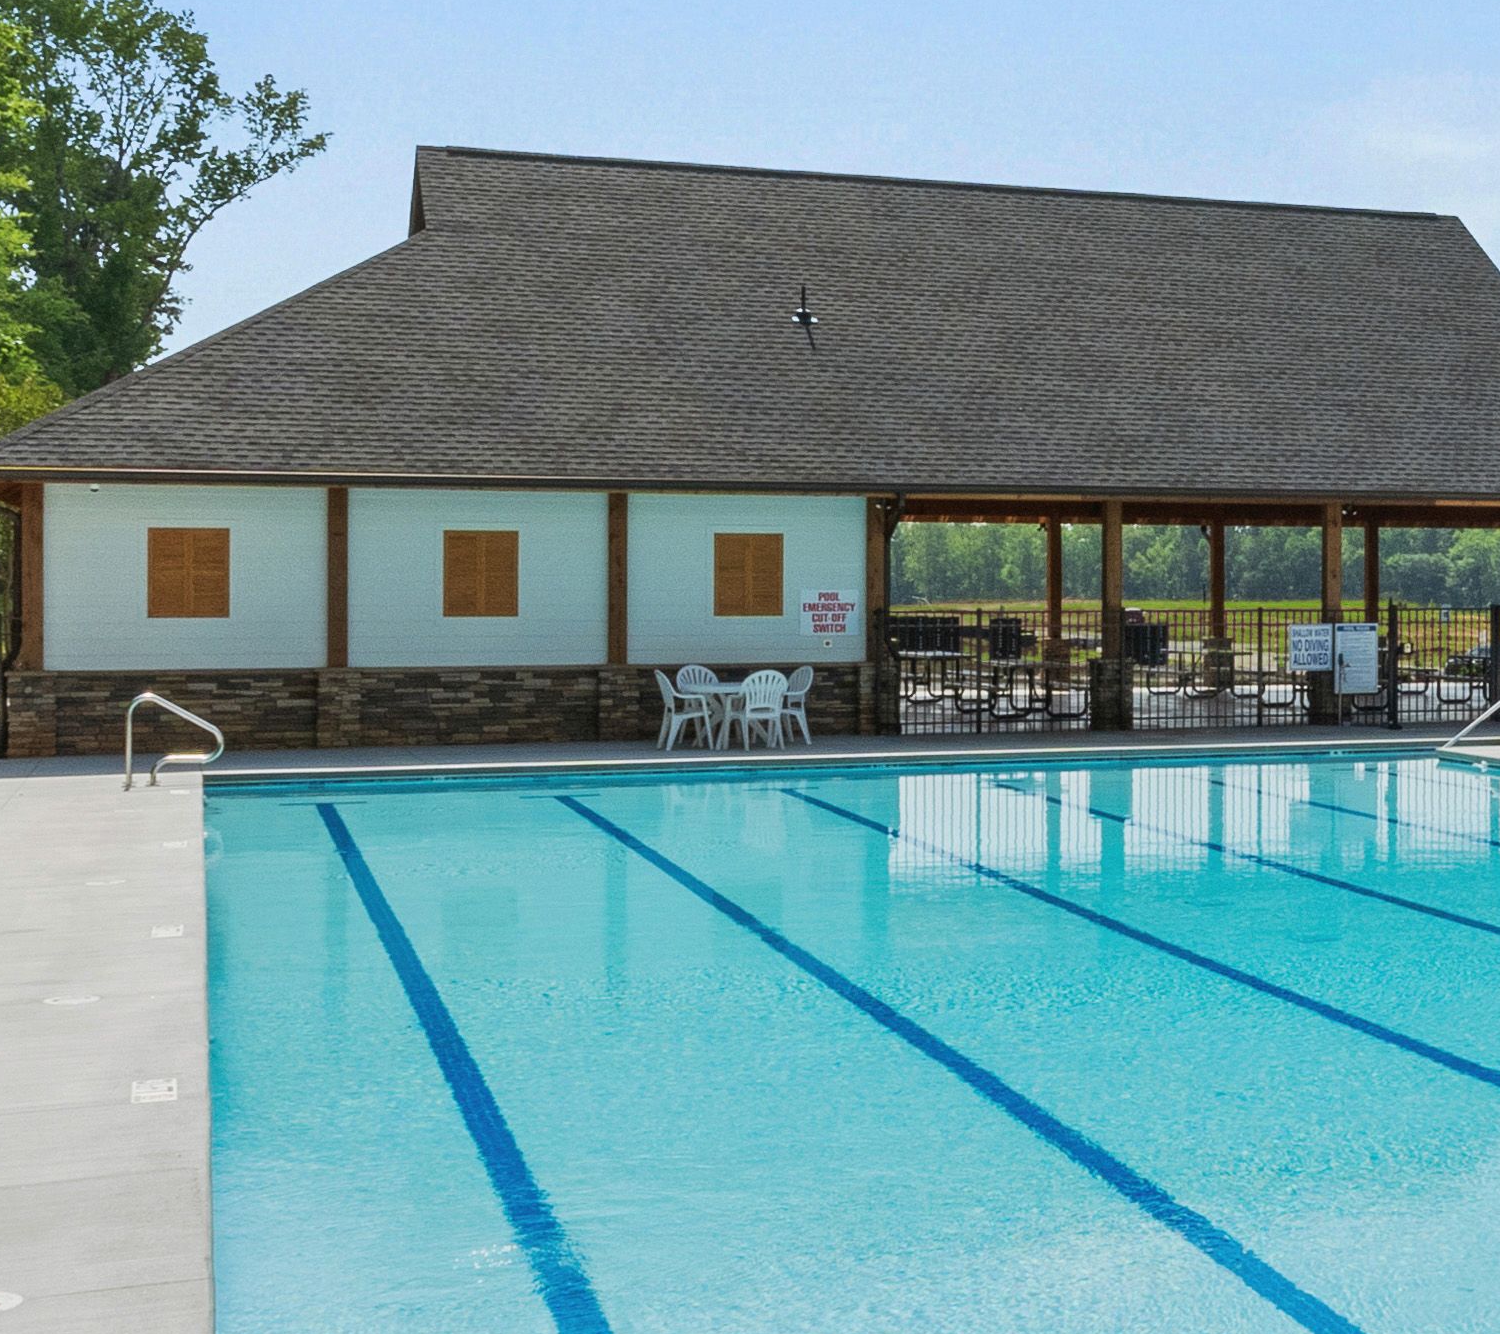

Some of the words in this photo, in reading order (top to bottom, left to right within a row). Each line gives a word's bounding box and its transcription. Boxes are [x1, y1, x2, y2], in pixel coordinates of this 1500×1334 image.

[818, 592, 840, 601] POOL
[803, 602, 856, 612] EMERGENCY
[813, 624, 846, 633] SWITCH
[1292, 639, 1303, 651] NO
[1305, 638, 1329, 652] DIVING
[1293, 653, 1329, 666] ALLOWED
